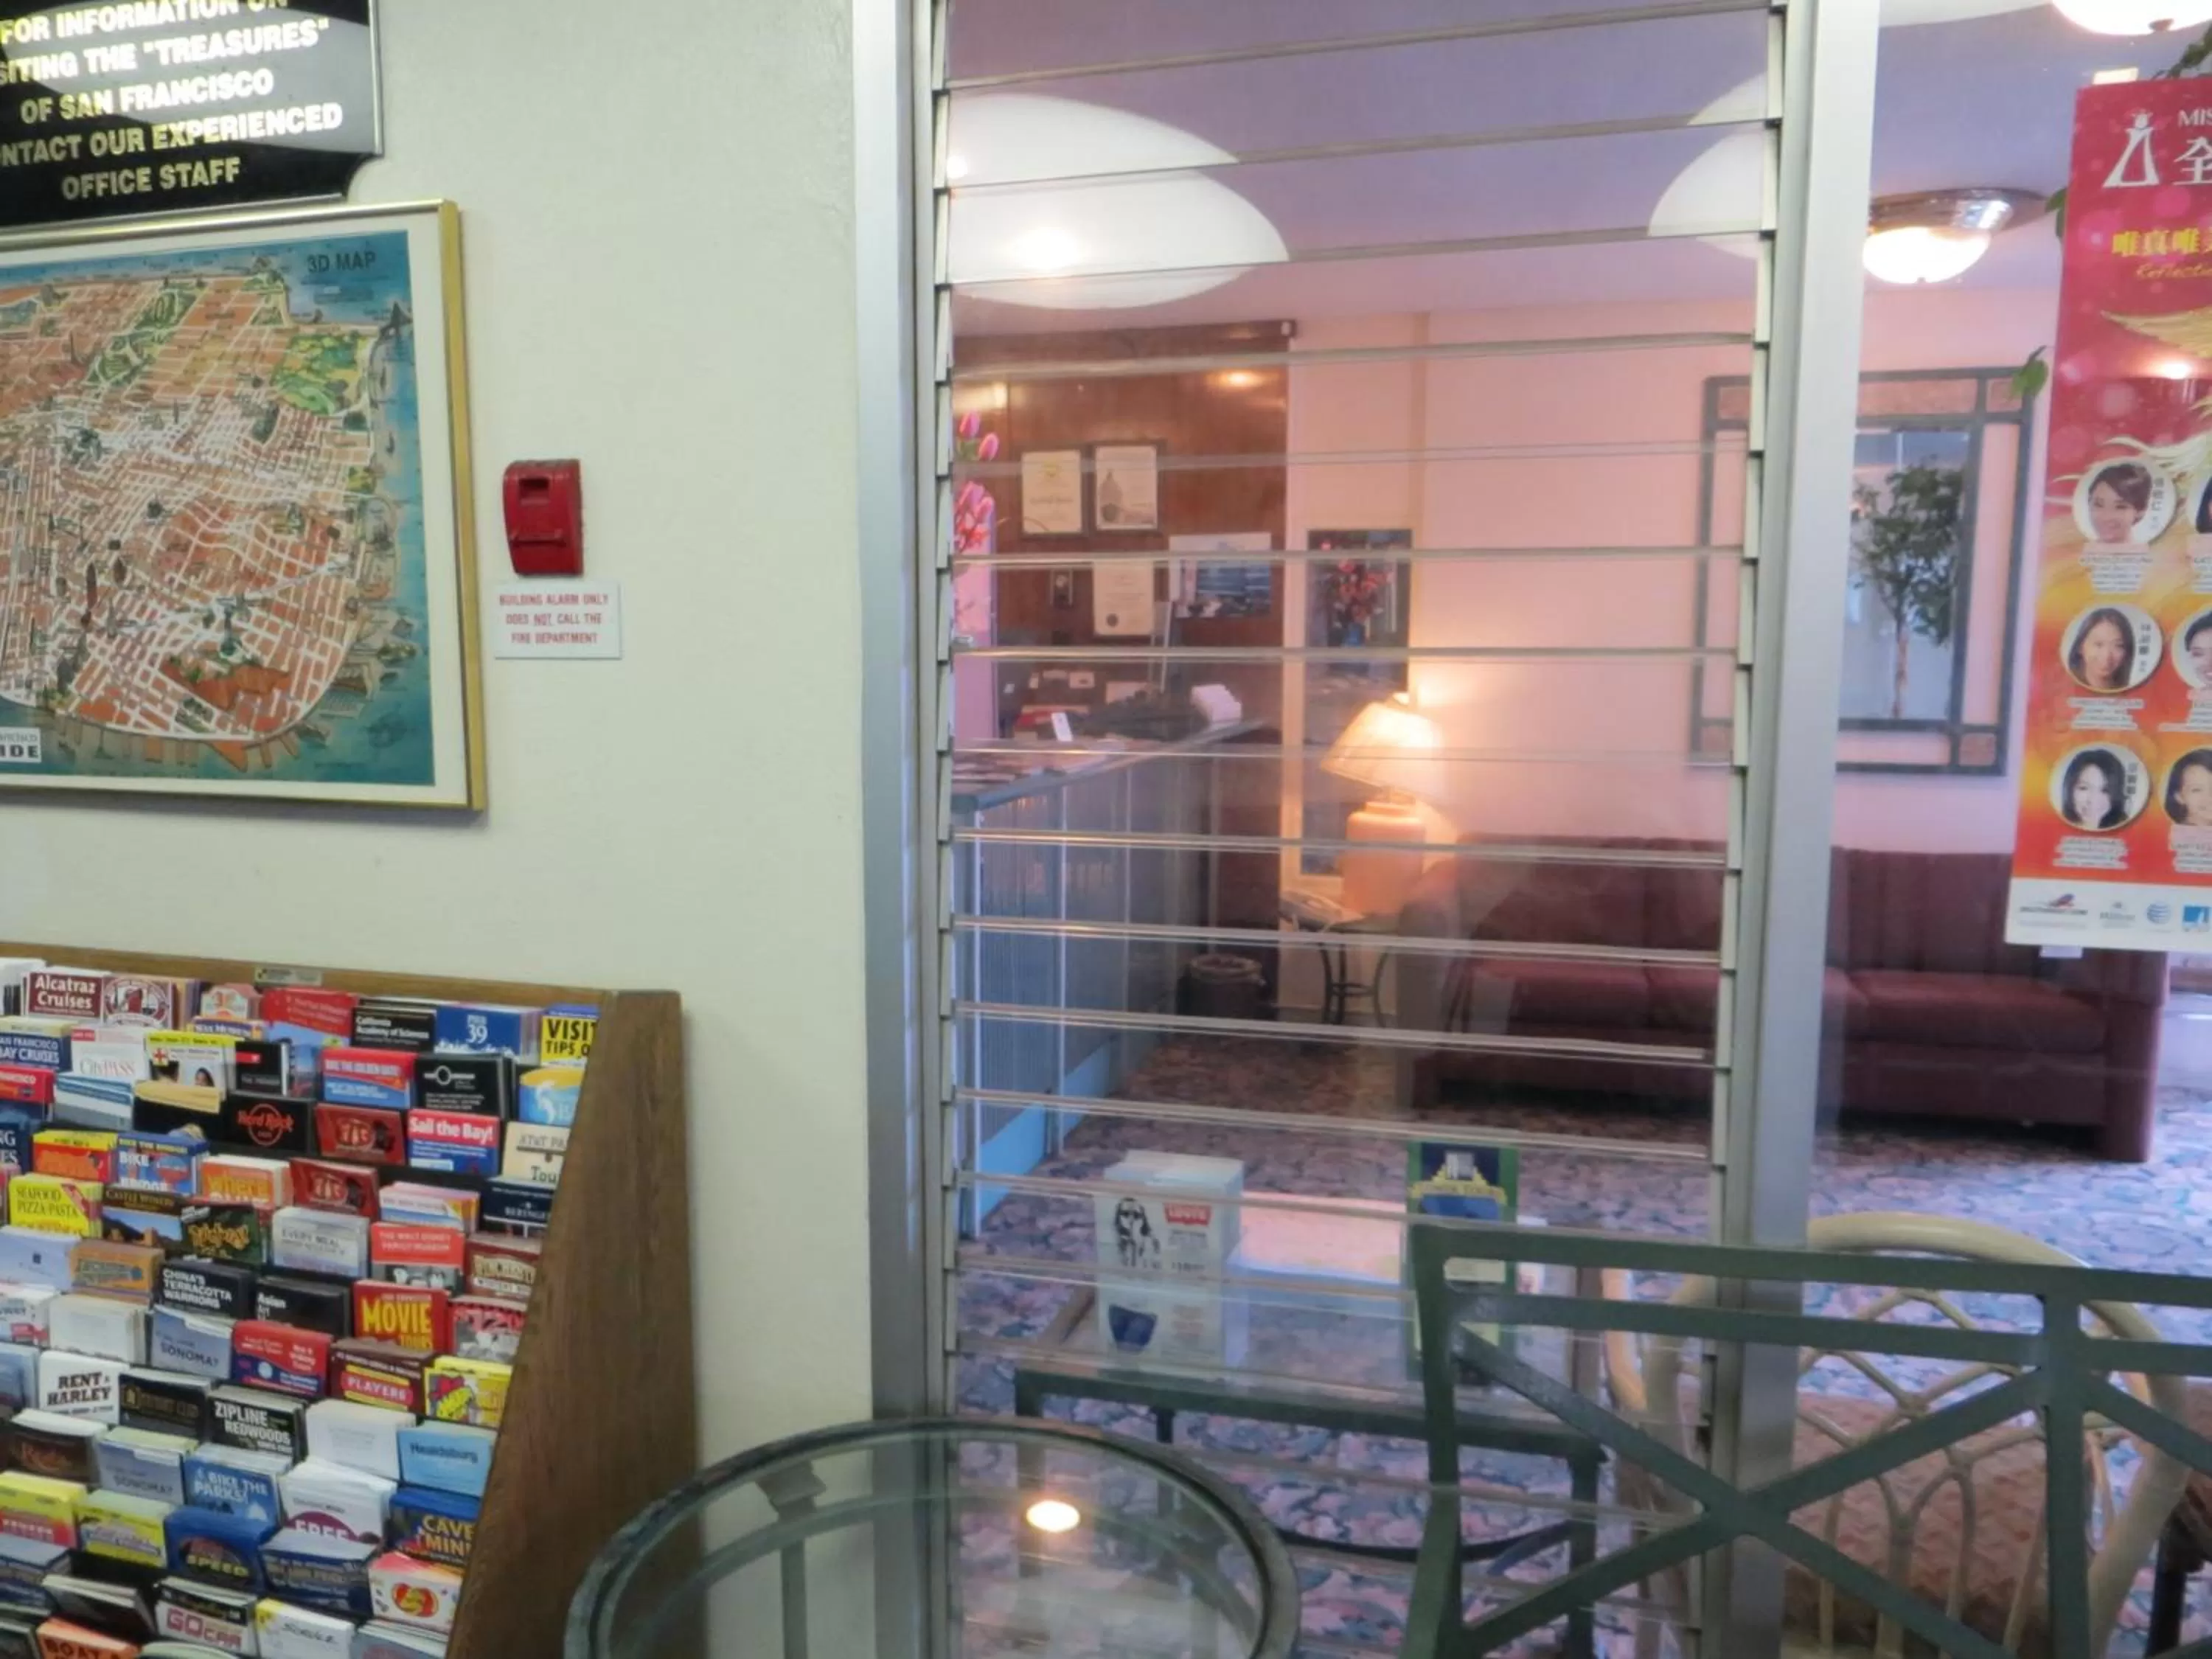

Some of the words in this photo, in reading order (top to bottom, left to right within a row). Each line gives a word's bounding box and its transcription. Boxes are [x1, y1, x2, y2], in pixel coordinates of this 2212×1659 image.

[0, 16, 50, 44] FOR
[83, 44, 138, 74] THE
[144, 18, 330, 66] "TREASURES"
[21, 100, 52, 124] OF
[60, 90, 114, 119] SAN
[121, 69, 274, 111] FRANCISCO
[90, 127, 145, 156] OUR
[152, 102, 343, 149] EXPERIENCED
[62, 170, 152, 200] OFFICE
[160, 157, 241, 191] STAFF
[307, 254, 330, 274] 3D
[336, 251, 376, 271] MAP
[499, 594, 543, 606] BUILDING
[546, 594, 579, 605] ALARM
[583, 594, 608, 605] ONLY
[506, 613, 529, 625] DOES
[534, 613, 552, 625] NOT
[557, 613, 580, 625] CALL
[584, 613, 602, 624] THE
[511, 633, 530, 644] FIRE
[535, 633, 597, 644] DEPARTMENT
[35, 975, 97, 995] Alcatraz
[37, 991, 94, 1010] Cruises
[466, 1025, 488, 1044] 39
[18, 1048, 60, 1065] CRUISES
[546, 1040, 574, 1056] TIPS
[409, 1115, 434, 1133] Sail
[437, 1120, 460, 1137] the
[463, 1122, 494, 1145] Bay!
[363, 1298, 432, 1335] MOVIE
[58, 1371, 102, 1390] RENT
[47, 1387, 112, 1406] HARLEY
[215, 1400, 268, 1427] ZIPLINE
[224, 1420, 291, 1447] REDWOODS
[422, 1515, 474, 1540] CAVE
